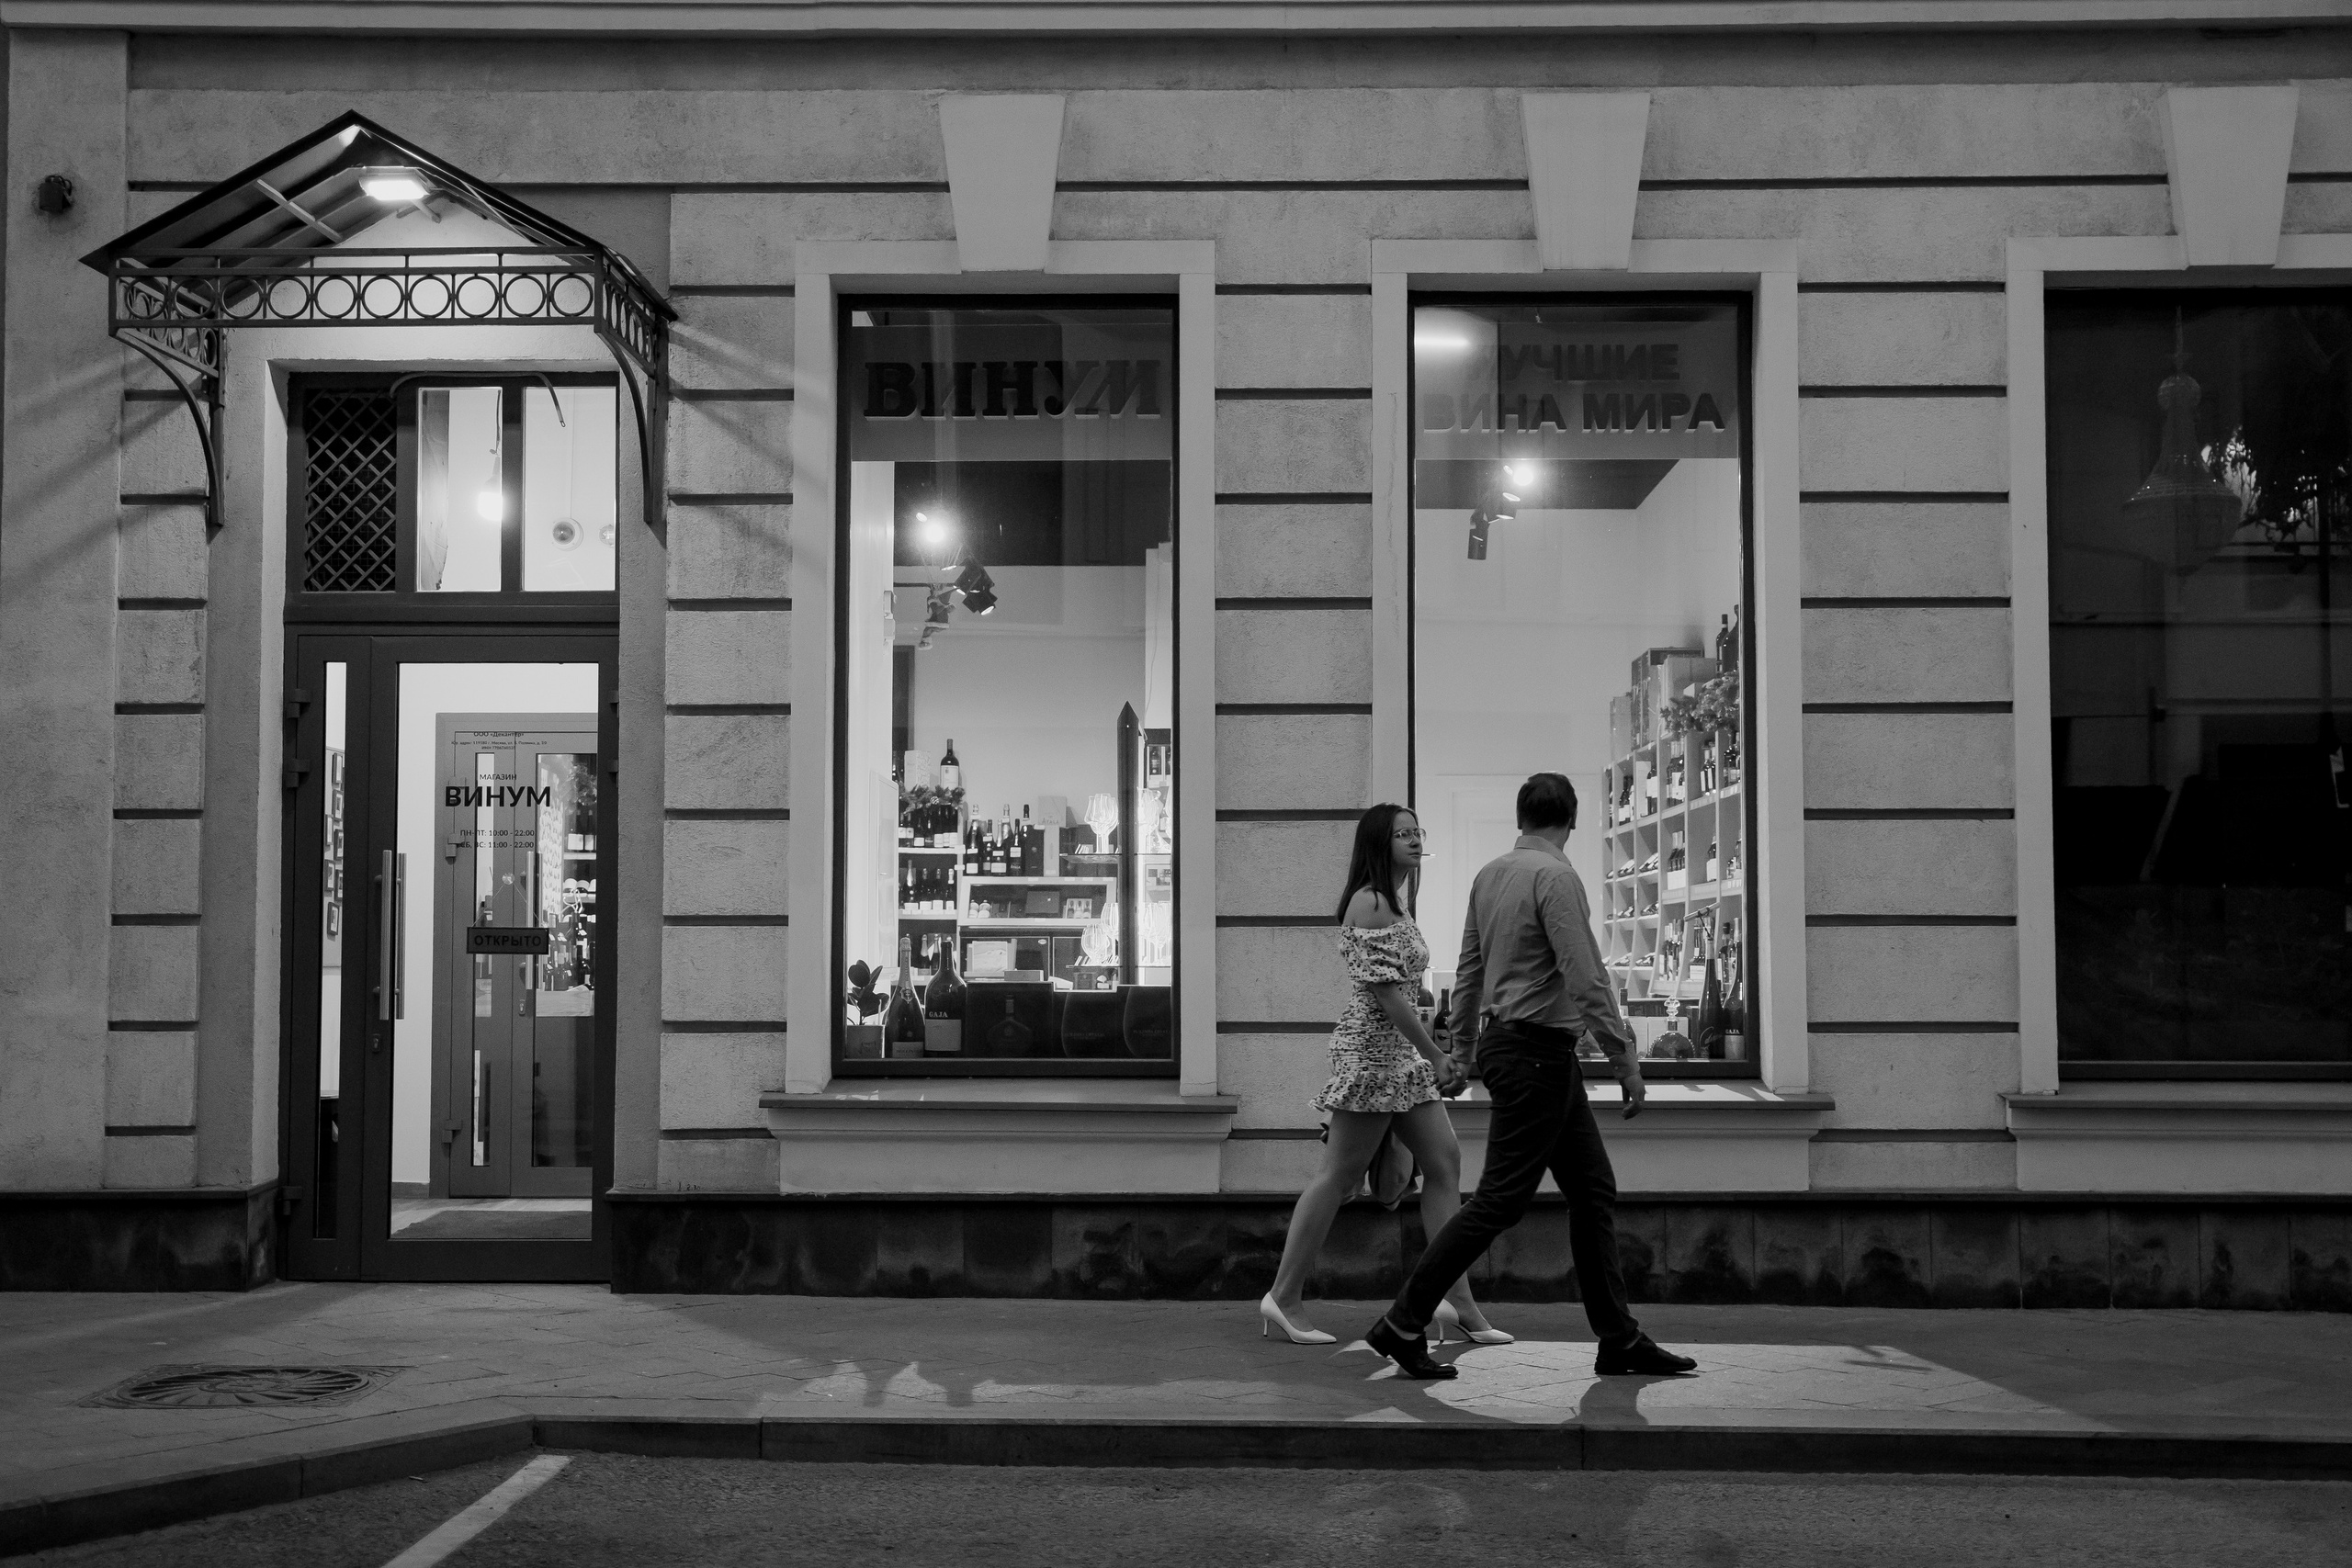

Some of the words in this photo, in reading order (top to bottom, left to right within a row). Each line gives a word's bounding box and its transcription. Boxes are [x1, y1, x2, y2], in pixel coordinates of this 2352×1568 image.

[864, 359, 1161, 420] ВИНУМ
[1423, 392, 1567, 433] ВИНА
[1581, 392, 1725, 433] МИРА
[445, 785, 551, 807] ВИНУМ
[474, 935, 541, 946] ОТКРЫТО
